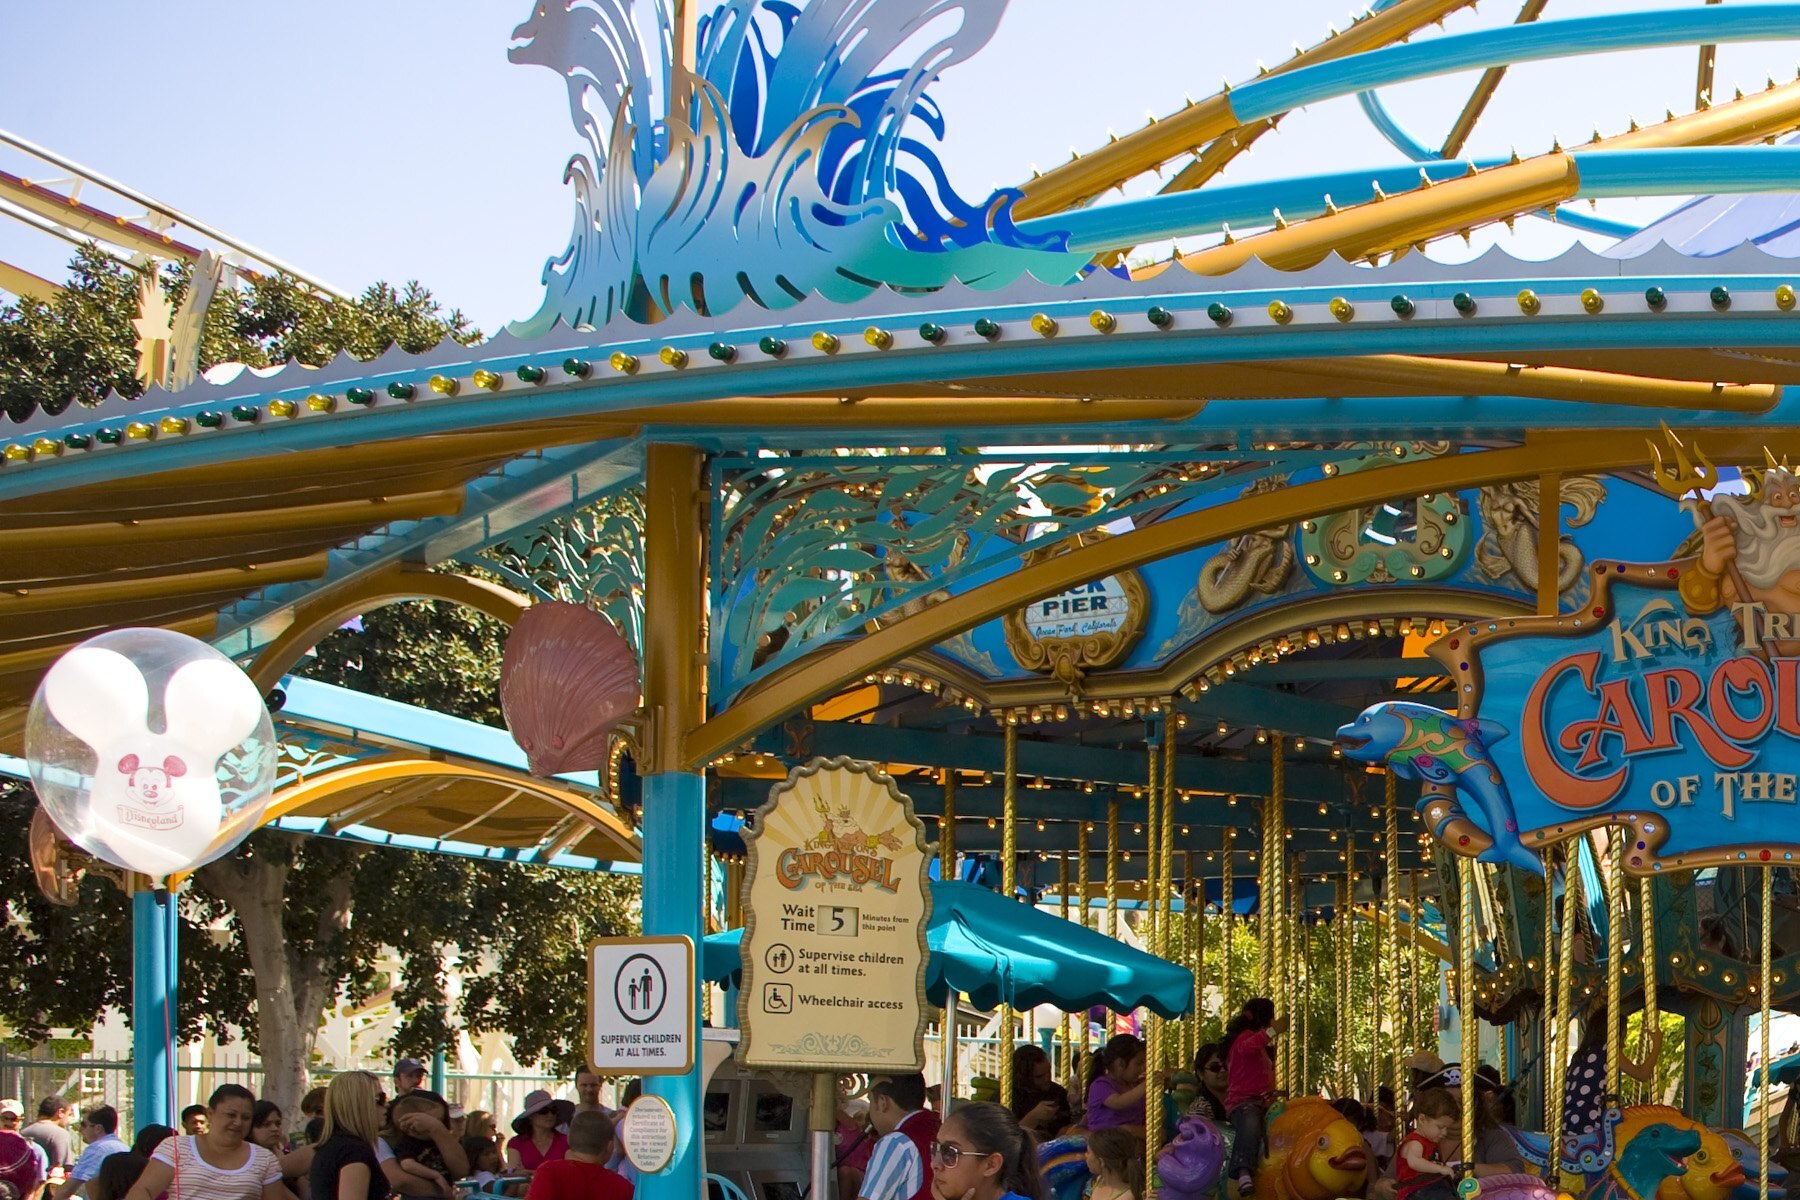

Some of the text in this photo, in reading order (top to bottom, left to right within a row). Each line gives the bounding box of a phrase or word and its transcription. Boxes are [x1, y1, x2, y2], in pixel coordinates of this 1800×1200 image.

[1043, 596, 1108, 616] PIER
[1608, 598, 1711, 664] KING
[1650, 774, 1701, 808] OF
[1714, 771, 1798, 821] THE
[126, 809, 177, 828] Disneyland
[776, 848, 901, 893] CAROUSEL
[783, 904, 815, 918] Wait
[862, 914, 909, 923] Minutes from
[781, 918, 815, 932] Time
[831, 907, 845, 932] 5
[799, 948, 904, 964] Supervise children
[798, 964, 867, 976] at all times.
[798, 994, 904, 1010] Wheelchair access
[601, 1034, 682, 1044] SUPERVISE CHILDREN
[615, 1047, 667, 1057] AT ALL TIMES.
